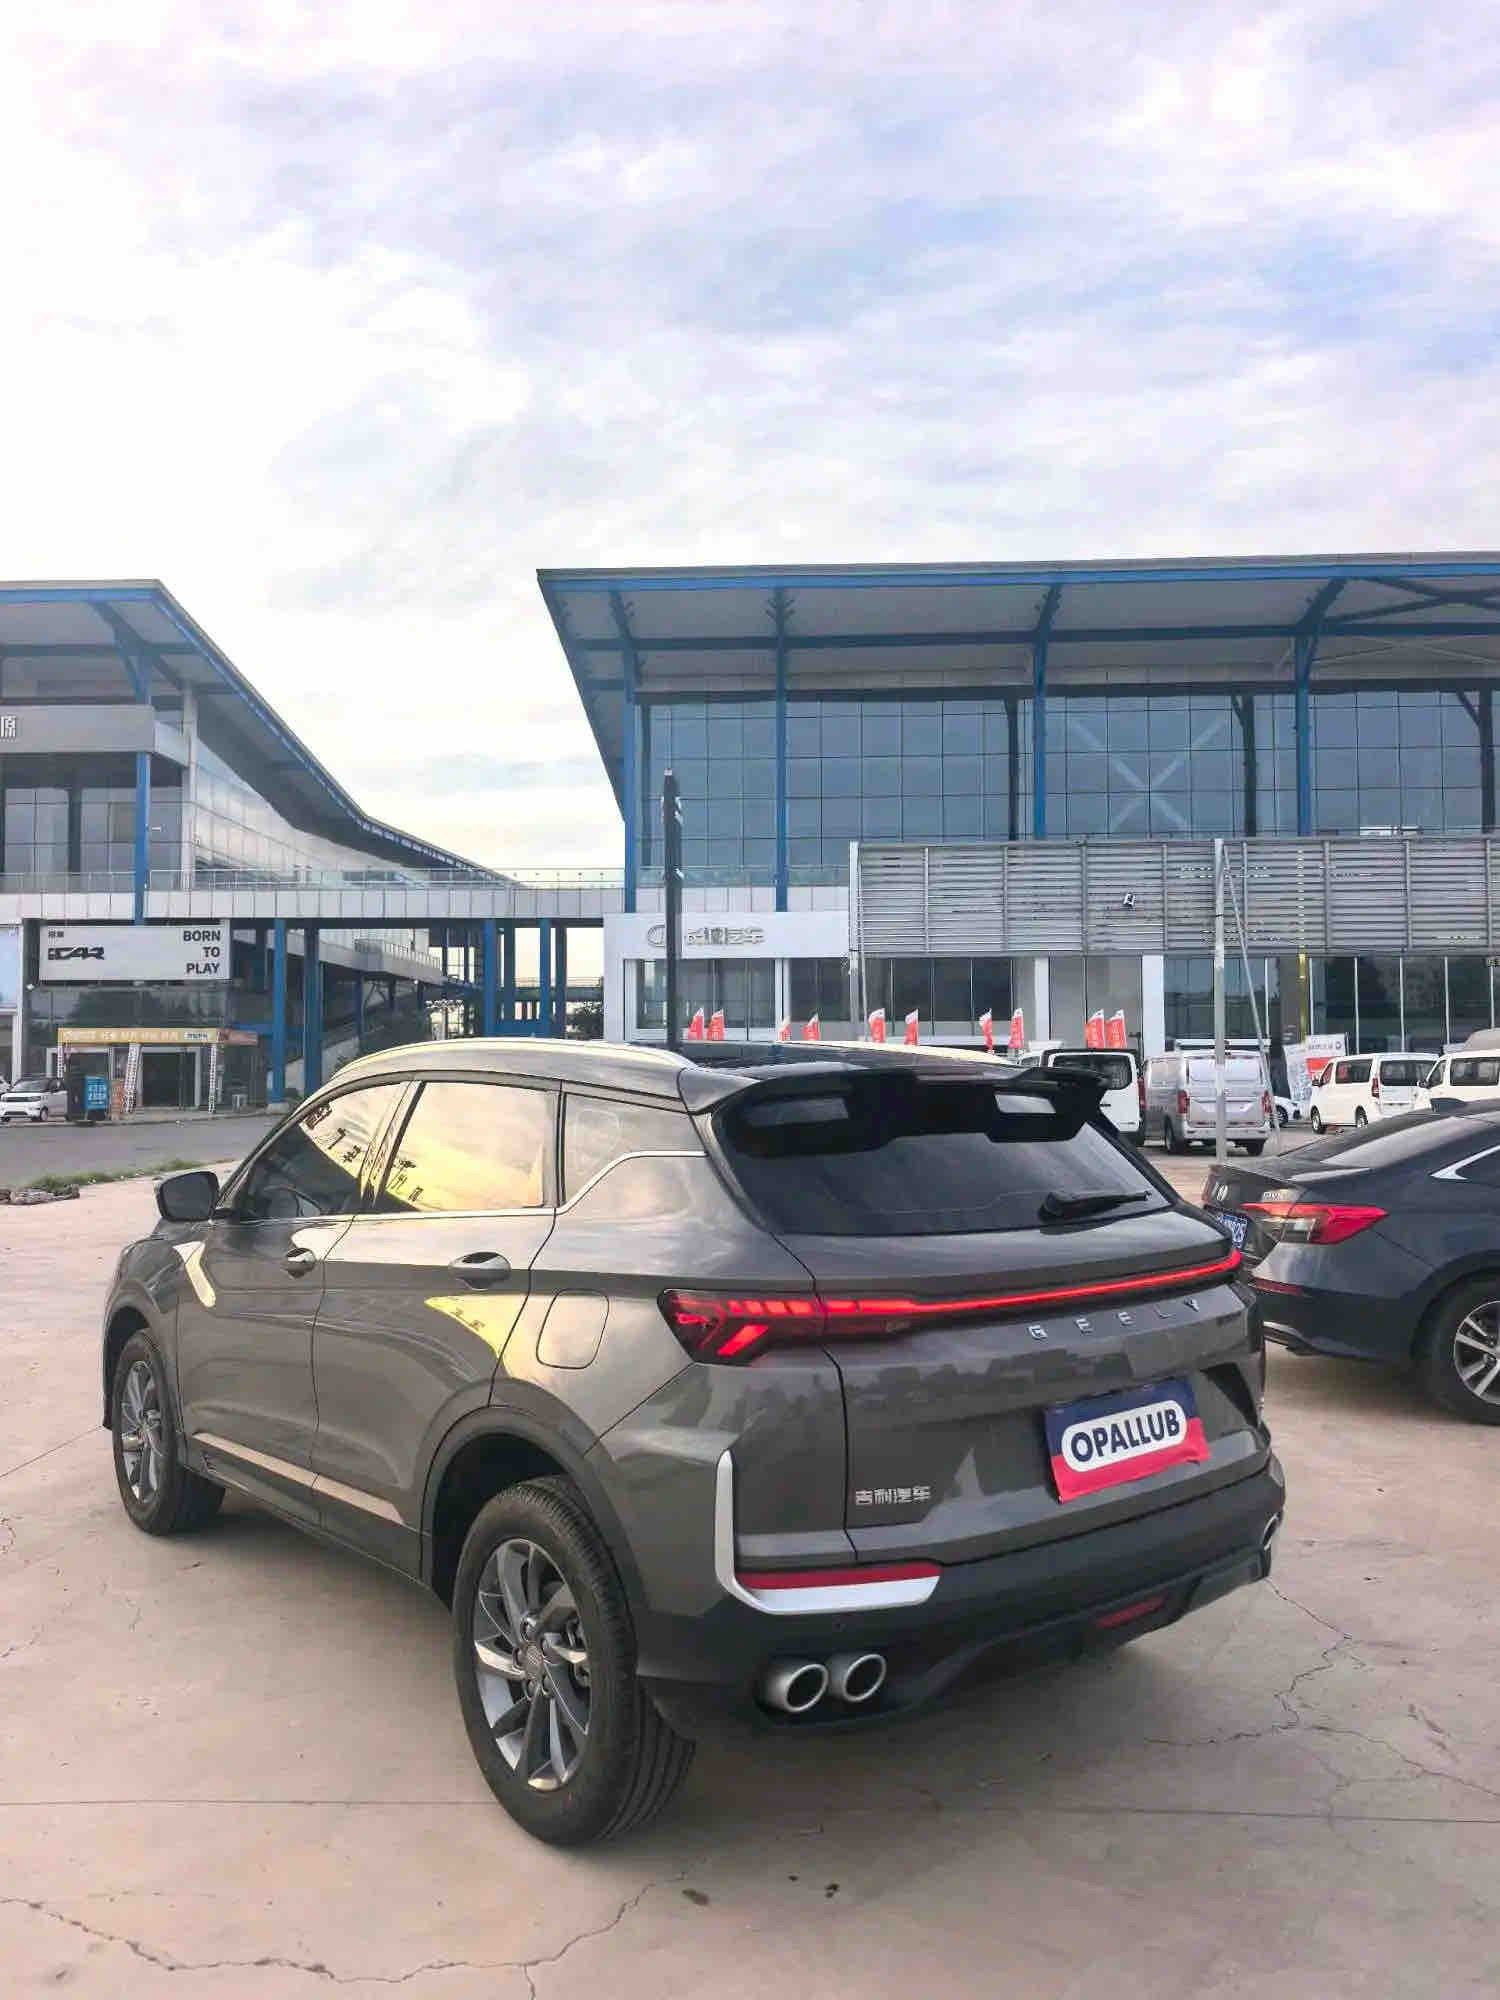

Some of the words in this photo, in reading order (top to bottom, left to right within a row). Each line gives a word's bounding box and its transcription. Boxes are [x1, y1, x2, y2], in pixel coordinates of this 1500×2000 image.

[183, 930, 221, 942] BORN
[202, 946, 220, 958] TO
[186, 962, 220, 974] PLAY
[1027, 1298, 1201, 1341] GEELY
[1070, 1408, 1180, 1463] OPALLUB
[855, 1485, 931, 1505] 吉利汽车
